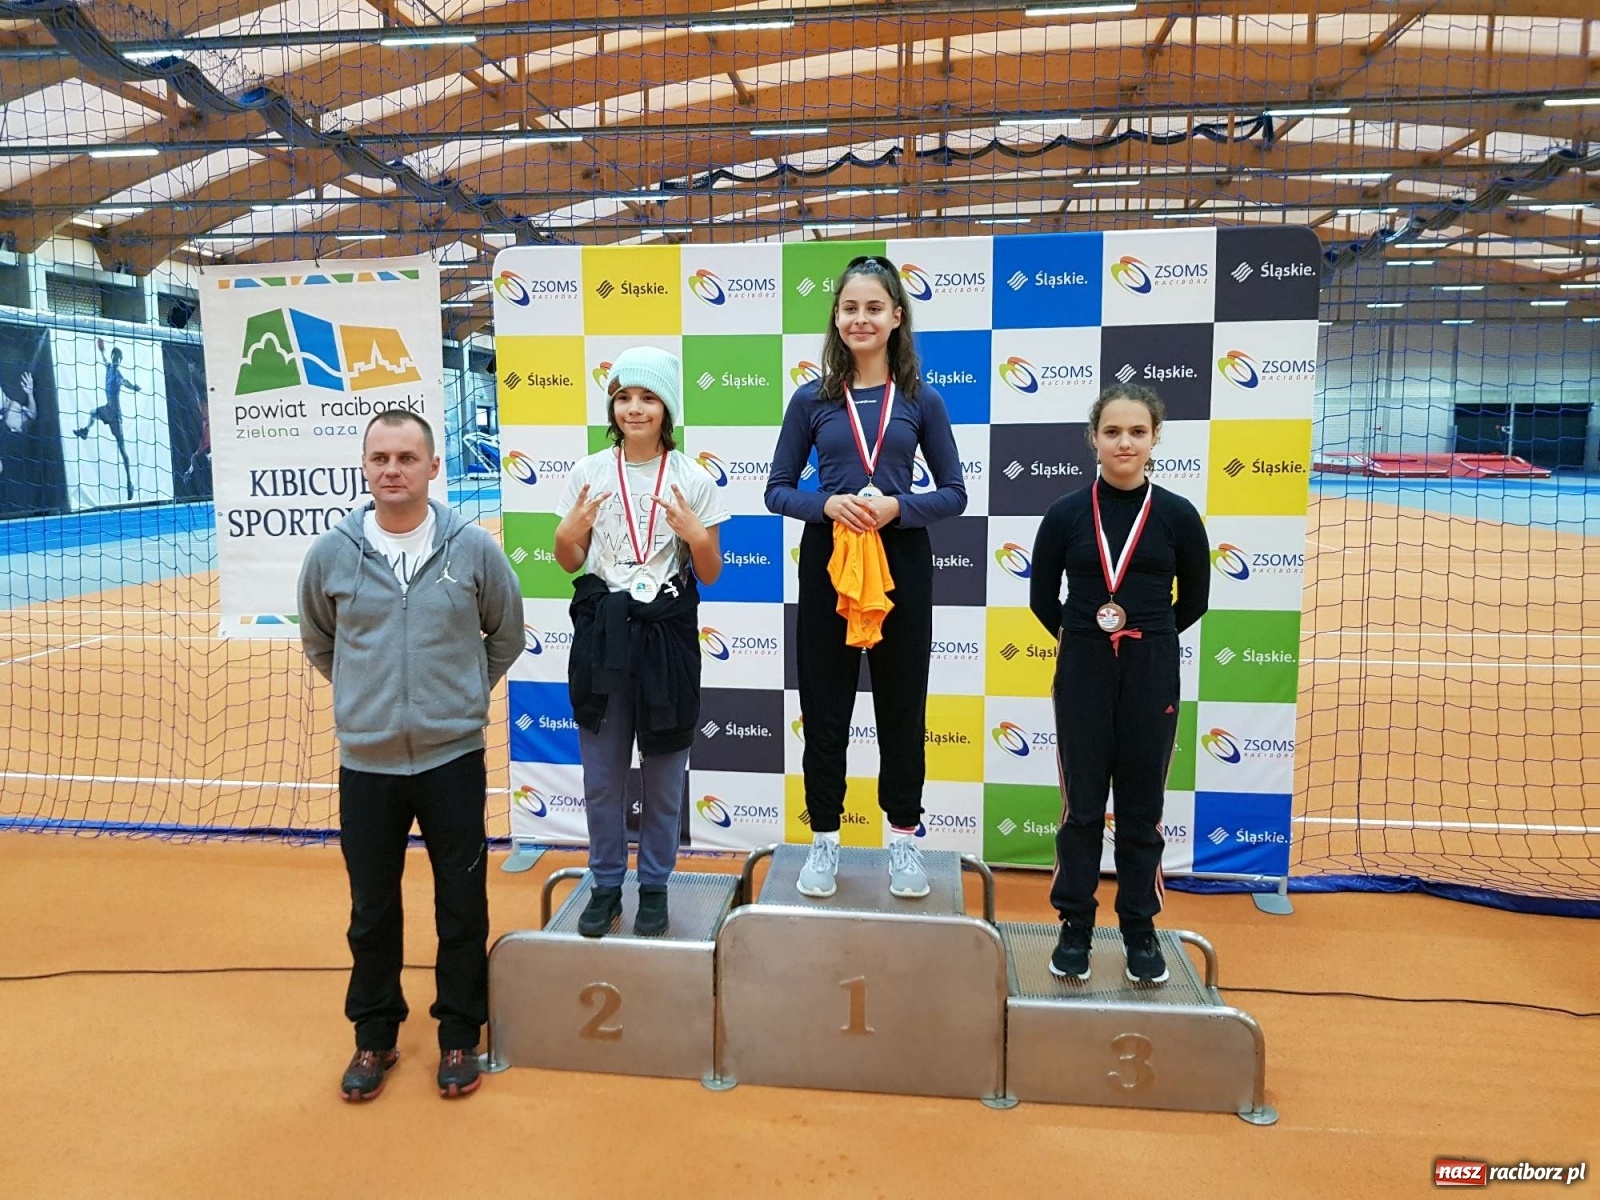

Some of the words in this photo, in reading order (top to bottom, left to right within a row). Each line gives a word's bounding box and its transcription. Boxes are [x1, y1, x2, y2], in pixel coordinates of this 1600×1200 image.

[1155, 263, 1208, 278] ZSOMS
[1261, 262, 1316, 280] Śląskie.
[532, 280, 578, 293] ZSOMS
[728, 279, 775, 291] ZSOMS
[935, 272, 985, 286] ZSOMS
[1035, 271, 1088, 288] Śląskie.
[621, 281, 668, 297] Śląskie.
[1041, 365, 1093, 380] ZSOMS
[1144, 364, 1197, 381] Śląskie.
[1262, 359, 1315, 373] ZSOMS
[528, 372, 573, 388] Śląskie.
[721, 372, 769, 388] Śląskie.
[926, 370, 977, 387] Śląskie.
[235, 399, 307, 424] powiat
[236, 425, 300, 439] zielona
[313, 425, 358, 437] oaza
[539, 460, 576, 473] ZSOM
[1031, 461, 1082, 478] Śląskie.
[1252, 460, 1305, 476] Śląskie.
[228, 508, 356, 537] SPORTO
[724, 552, 770, 567] Śląskie.
[932, 554, 973, 569] ląskie.
[1253, 554, 1304, 567] ZSOMS
[732, 637, 777, 649] ZSOMS
[930, 641, 978, 654] ZSOMS
[1243, 649, 1296, 665] Śląskie.
[539, 716, 579, 731] Śląskie
[726, 723, 771, 738] Śląskie.
[1033, 732, 1057, 746] ZSO
[1244, 739, 1295, 752] ZSOMS
[550, 795, 586, 808] ZSOM
[734, 805, 778, 817] ZSOMS
[842, 812, 869, 825] skie.
[929, 815, 976, 828] ZSOMS
[1023, 820, 1058, 835] Śląsk
[1236, 828, 1288, 844] Śląskie.
[579, 982, 622, 1039] 2
[839, 976, 876, 1035] 1
[1107, 1033, 1156, 1089] 3
